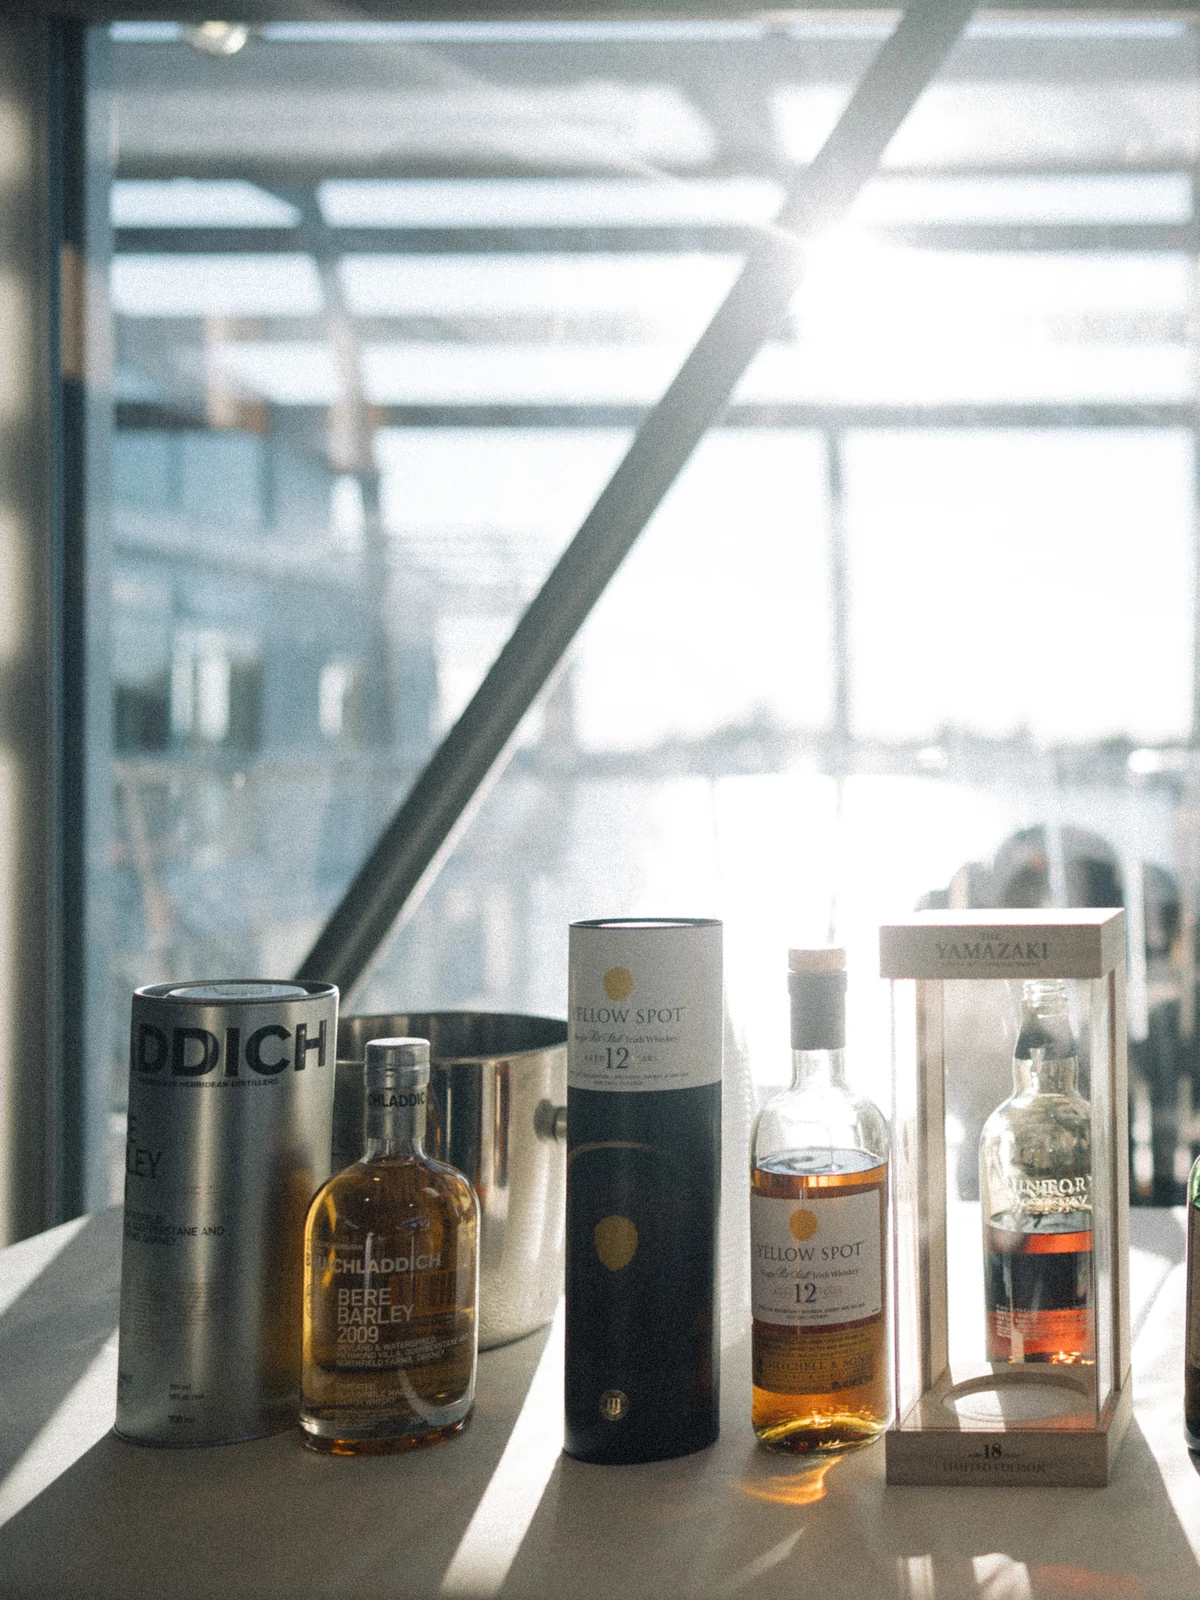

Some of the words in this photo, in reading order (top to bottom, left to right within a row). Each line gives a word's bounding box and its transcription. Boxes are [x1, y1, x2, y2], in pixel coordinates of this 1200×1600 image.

[935, 941, 1047, 960] YAMAZAKI
[574, 1006, 630, 1024] ELLOW
[636, 1005, 686, 1024] SPOT
[605, 1046, 629, 1070] 12
[203, 1225, 226, 1238] AND
[756, 1243, 816, 1262] YELLOW
[820, 1240, 865, 1261] SPOT
[338, 1287, 392, 1306] BERE
[795, 1281, 818, 1305] 12
[338, 1303, 415, 1325] BARLEY
[337, 1325, 379, 1344] 2009
[984, 1442, 1003, 1460] 18
